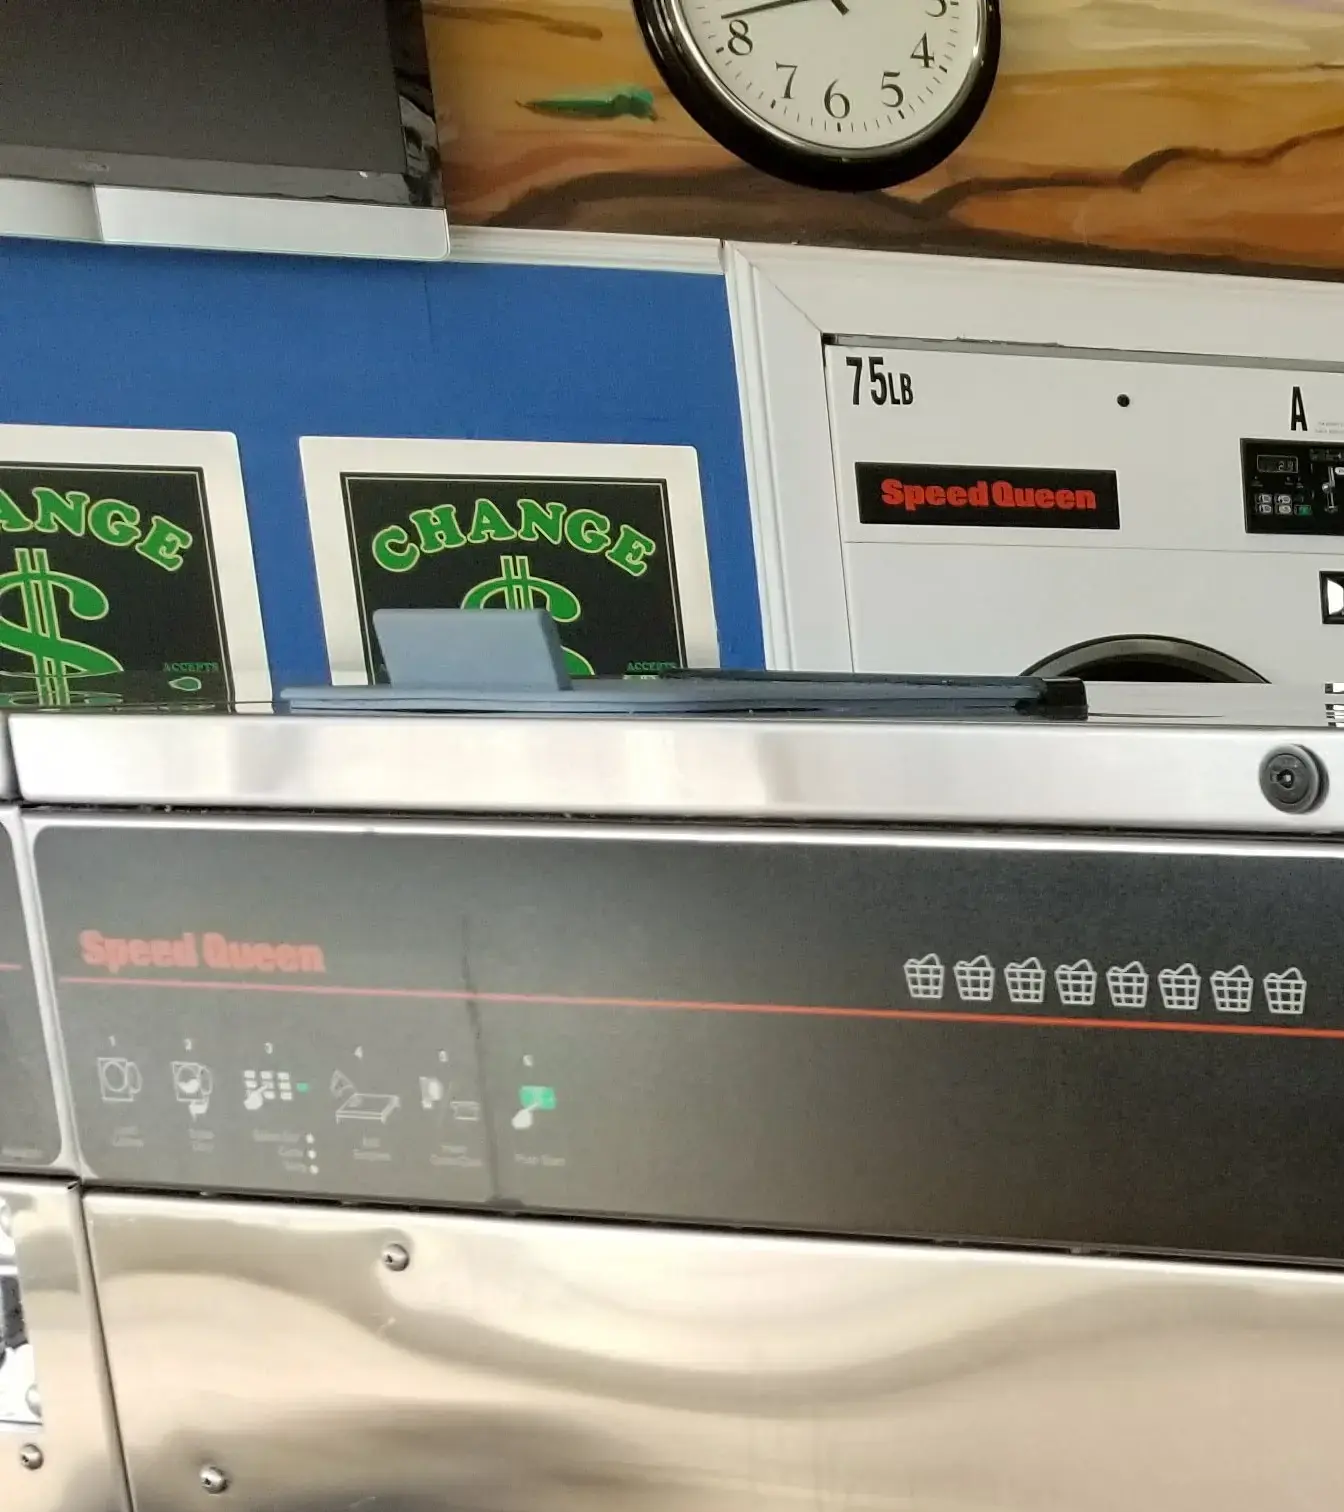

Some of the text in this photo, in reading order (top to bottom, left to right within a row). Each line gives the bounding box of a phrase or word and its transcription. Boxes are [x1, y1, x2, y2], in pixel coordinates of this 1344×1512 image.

[727, 19, 754, 56] 8
[910, 32, 935, 68] 4
[775, 62, 798, 99] 7
[824, 79, 850, 119] 6
[881, 71, 904, 107] 5
[846, 356, 914, 406] 75LB
[1290, 386, 1309, 432] A
[881, 478, 1097, 511] Speed Queen
[372, 498, 656, 577] CHANGE
[80, 930, 325, 974] Speed Queen
